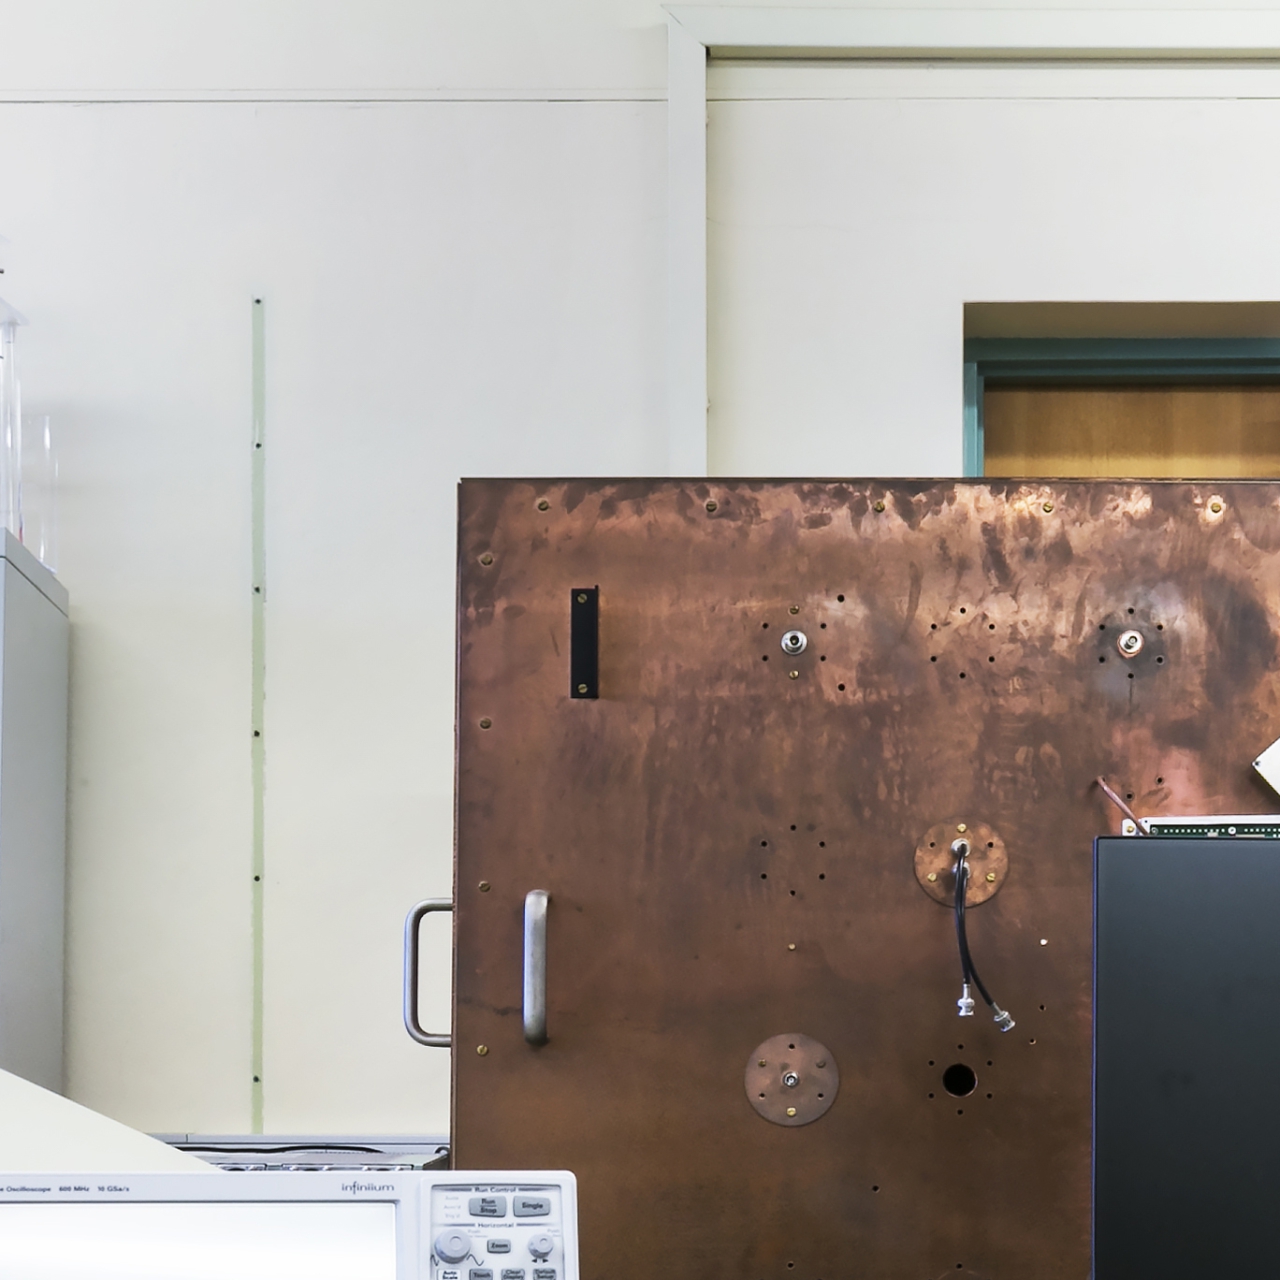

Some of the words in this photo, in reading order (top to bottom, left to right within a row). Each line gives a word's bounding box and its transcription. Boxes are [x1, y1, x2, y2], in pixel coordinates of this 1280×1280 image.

[6, 1185, 51, 1193] Oscilloscope
[341, 1180, 395, 1195] infiniium
[521, 1202, 544, 1210] Single
